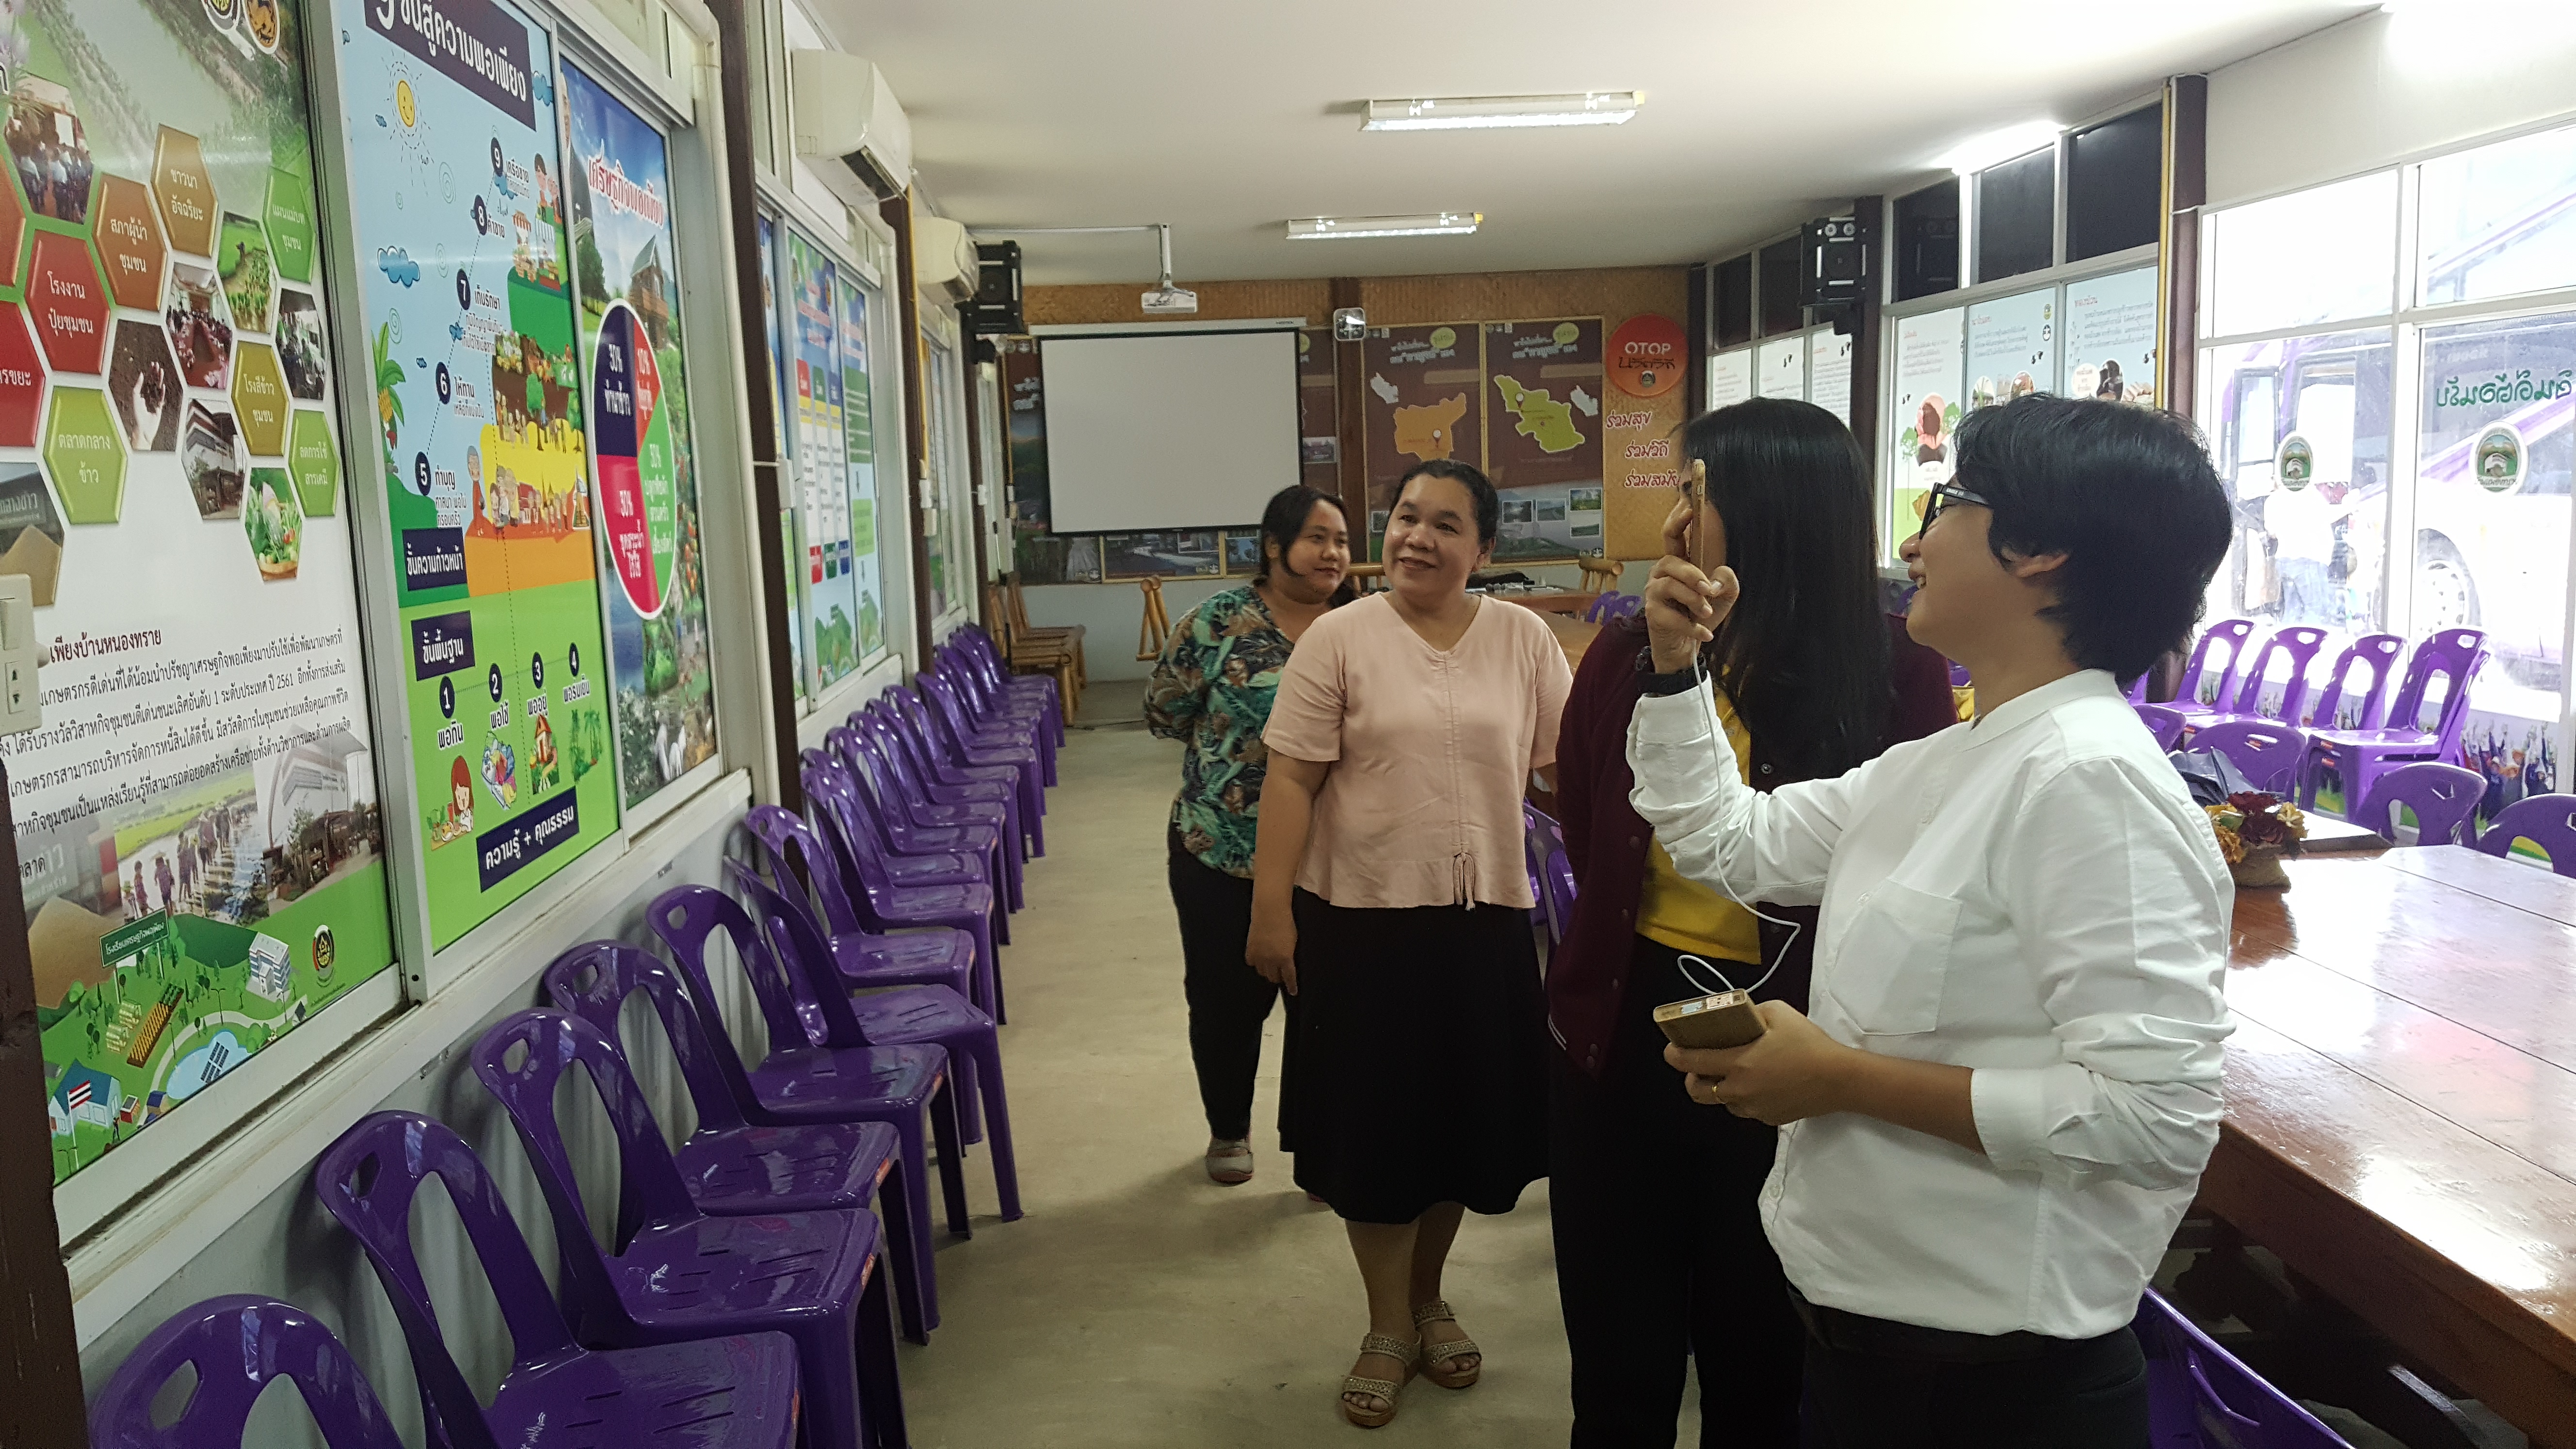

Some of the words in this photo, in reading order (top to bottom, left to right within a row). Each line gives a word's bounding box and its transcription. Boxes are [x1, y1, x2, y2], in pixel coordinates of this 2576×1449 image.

[494, 147, 500, 168] 9
[171, 169, 197, 190] ชาวนา
[172, 194, 203, 221] อัจฉริยะ
[478, 205, 484, 226] 8
[111, 216, 148, 245] สภาผู้นำ
[282, 235, 302, 252] ชุมชน
[120, 254, 147, 275] ชุมชน
[47, 270, 86, 299] โรงงาน
[460, 279, 466, 301] 7
[474, 284, 500, 310] เก็บรักษา
[48, 307, 94, 338] ปุ๋ยชุมชน
[608, 343, 623, 372] 30%
[1625, 341, 1671, 355] OTOP
[243, 373, 274, 396] โรงสีข้าว
[440, 372, 448, 395] 6
[454, 375, 474, 398] ให้ทาน
[253, 409, 274, 428] ชุมชน
[1606, 410, 1652, 430] ร่วมสุข
[58, 434, 111, 450] ตลาดกลาง
[300, 441, 327, 459] ลดการใช้
[1625, 440, 1669, 458] ร่วมวิถี
[79, 461, 99, 483] ข้าว
[305, 468, 328, 484] สารเคมี
[419, 462, 428, 486] 5
[435, 464, 456, 491] ทำบุญ
[407, 543, 463, 576] ขั้นความก้าวหน้า
[50, 629, 161, 663] เพียงบ้านหนองทราย
[422, 628, 464, 665] ขั้นพื้นฐาน
[535, 661, 541, 681] 3
[571, 650, 577, 670] 4
[214, 691, 219, 705] 1
[277, 673, 293, 690] 2561
[491, 674, 499, 694] 2
[444, 686, 451, 709] 1
[527, 689, 547, 716] พออยู่
[490, 702, 509, 728] พอใช้
[438, 721, 464, 749] พอกิน
[485, 829, 521, 870] ความรู้
[535, 805, 574, 844] คุณธรรม
